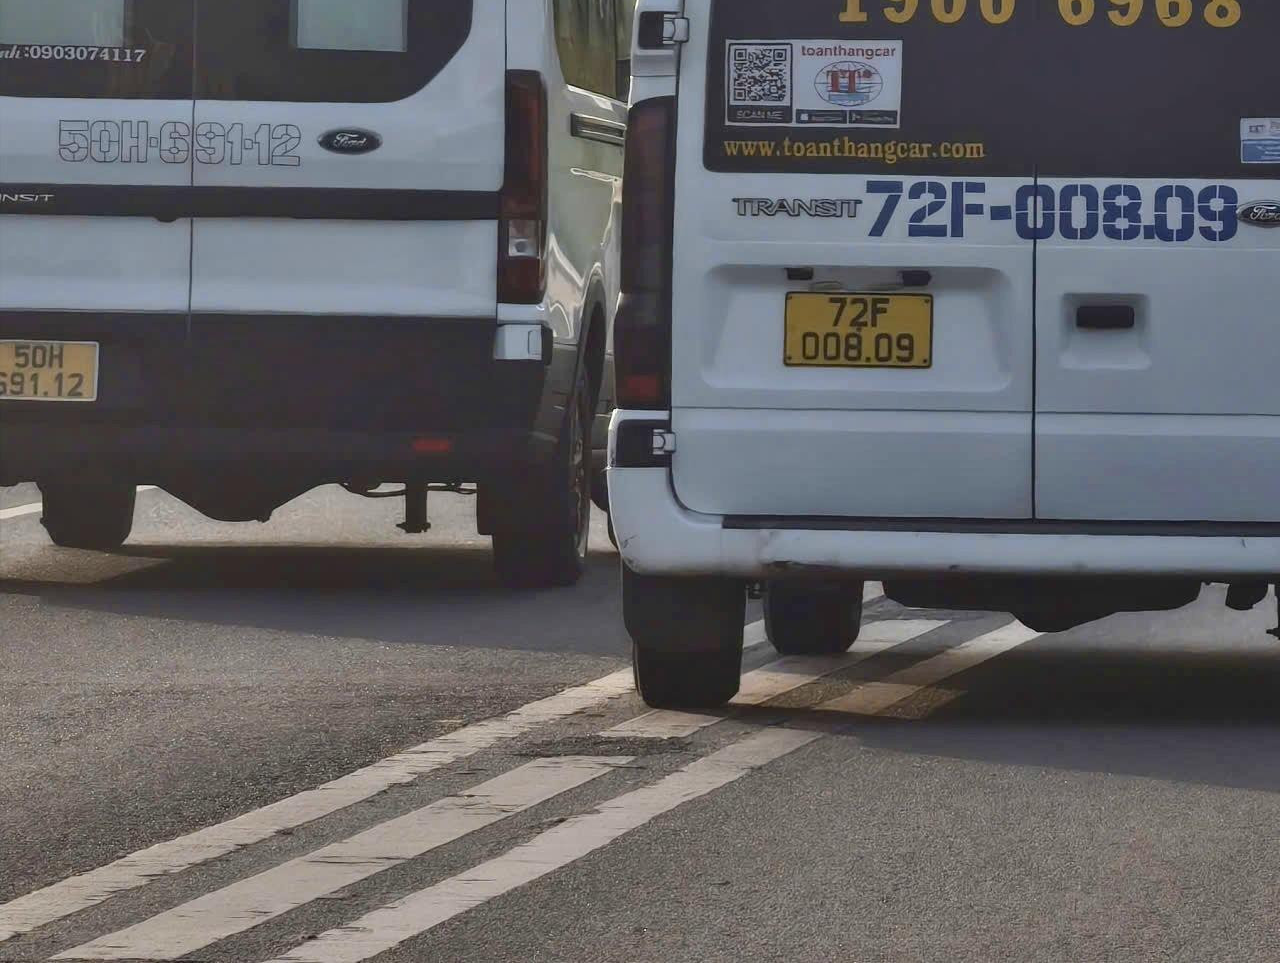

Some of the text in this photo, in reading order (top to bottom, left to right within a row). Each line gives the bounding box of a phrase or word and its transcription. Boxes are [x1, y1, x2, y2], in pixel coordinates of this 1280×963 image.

[801, 45, 896, 59] toanthangcar
[724, 137, 985, 163] www.toanthangcar.com
[732, 198, 863, 217] TRANSIT
[866, 180, 1239, 242] 72F-008.09
[828, 297, 890, 327] 72F
[15, 345, 64, 368] 50H
[802, 332, 914, 362] 008.09
